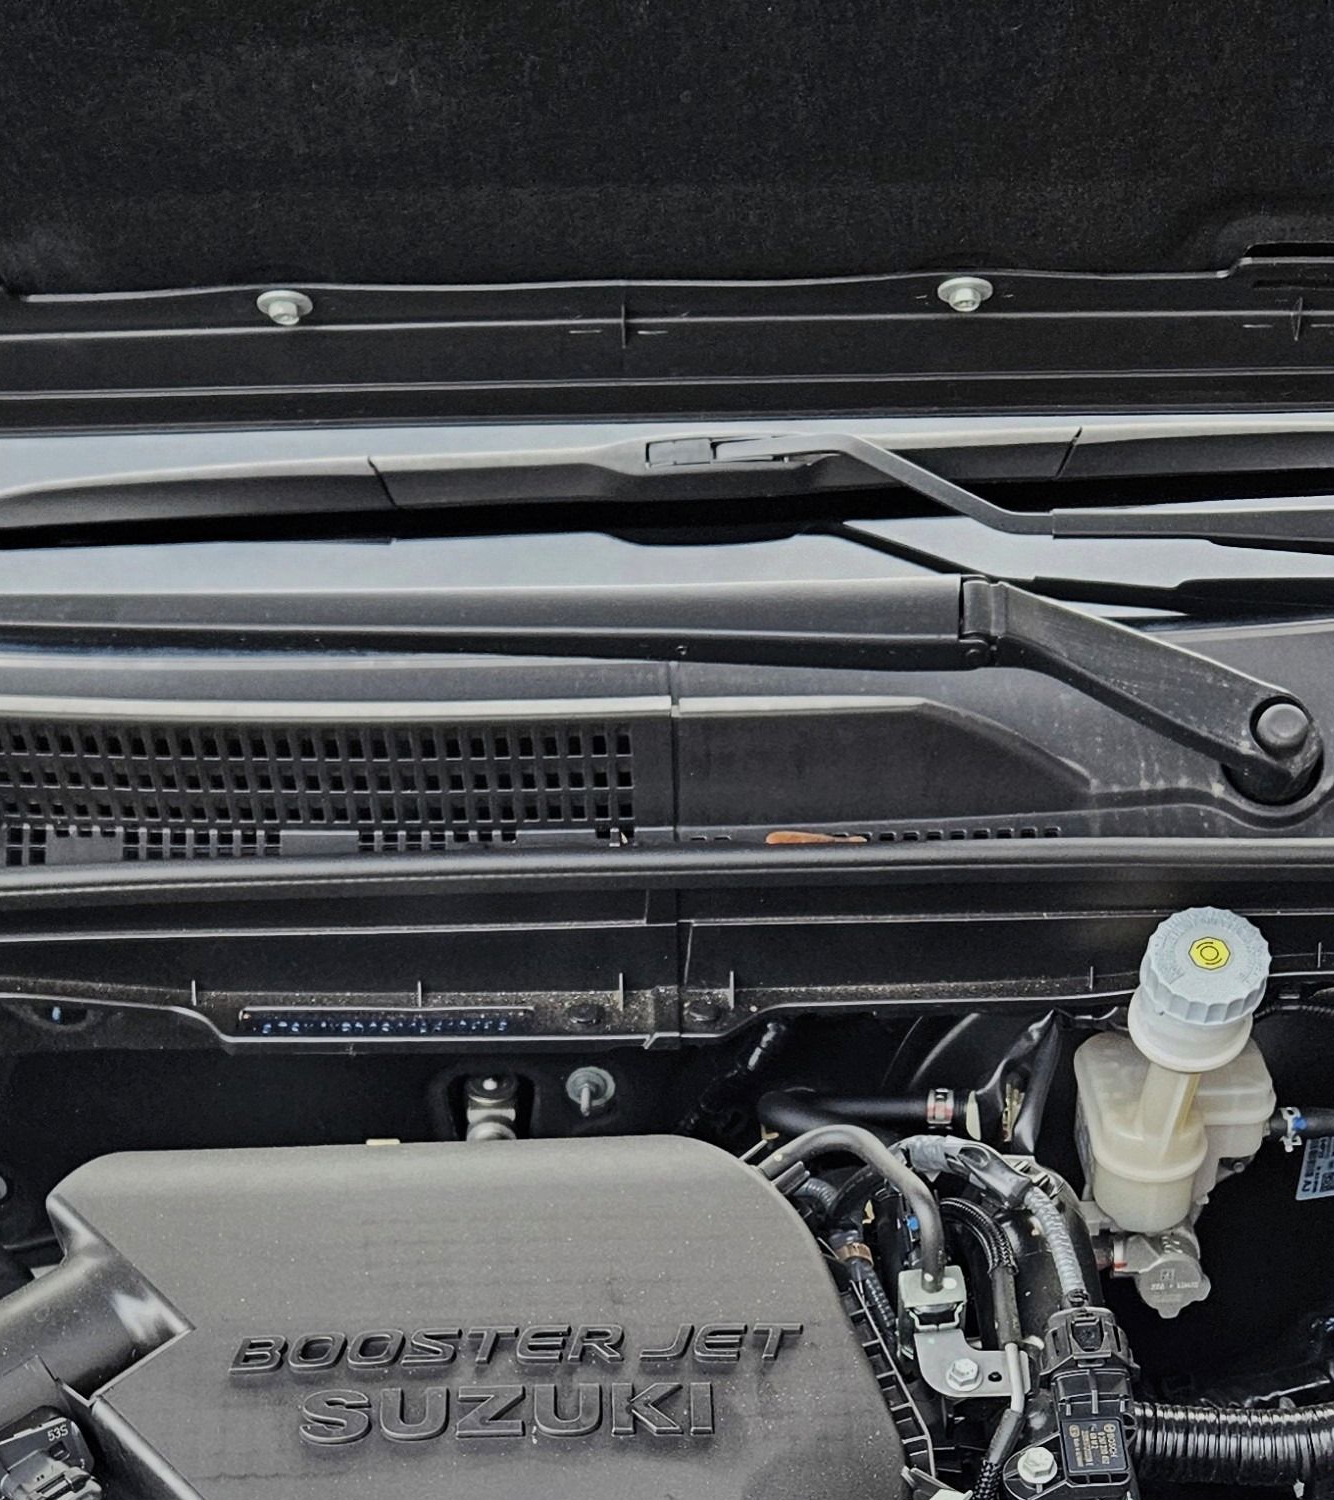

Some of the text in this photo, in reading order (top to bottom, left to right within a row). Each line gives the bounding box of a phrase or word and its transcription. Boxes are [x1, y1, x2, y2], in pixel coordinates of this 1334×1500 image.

[228, 1323, 804, 1374] BOOSTER JET
[299, 1382, 715, 1444] SUZUKI
